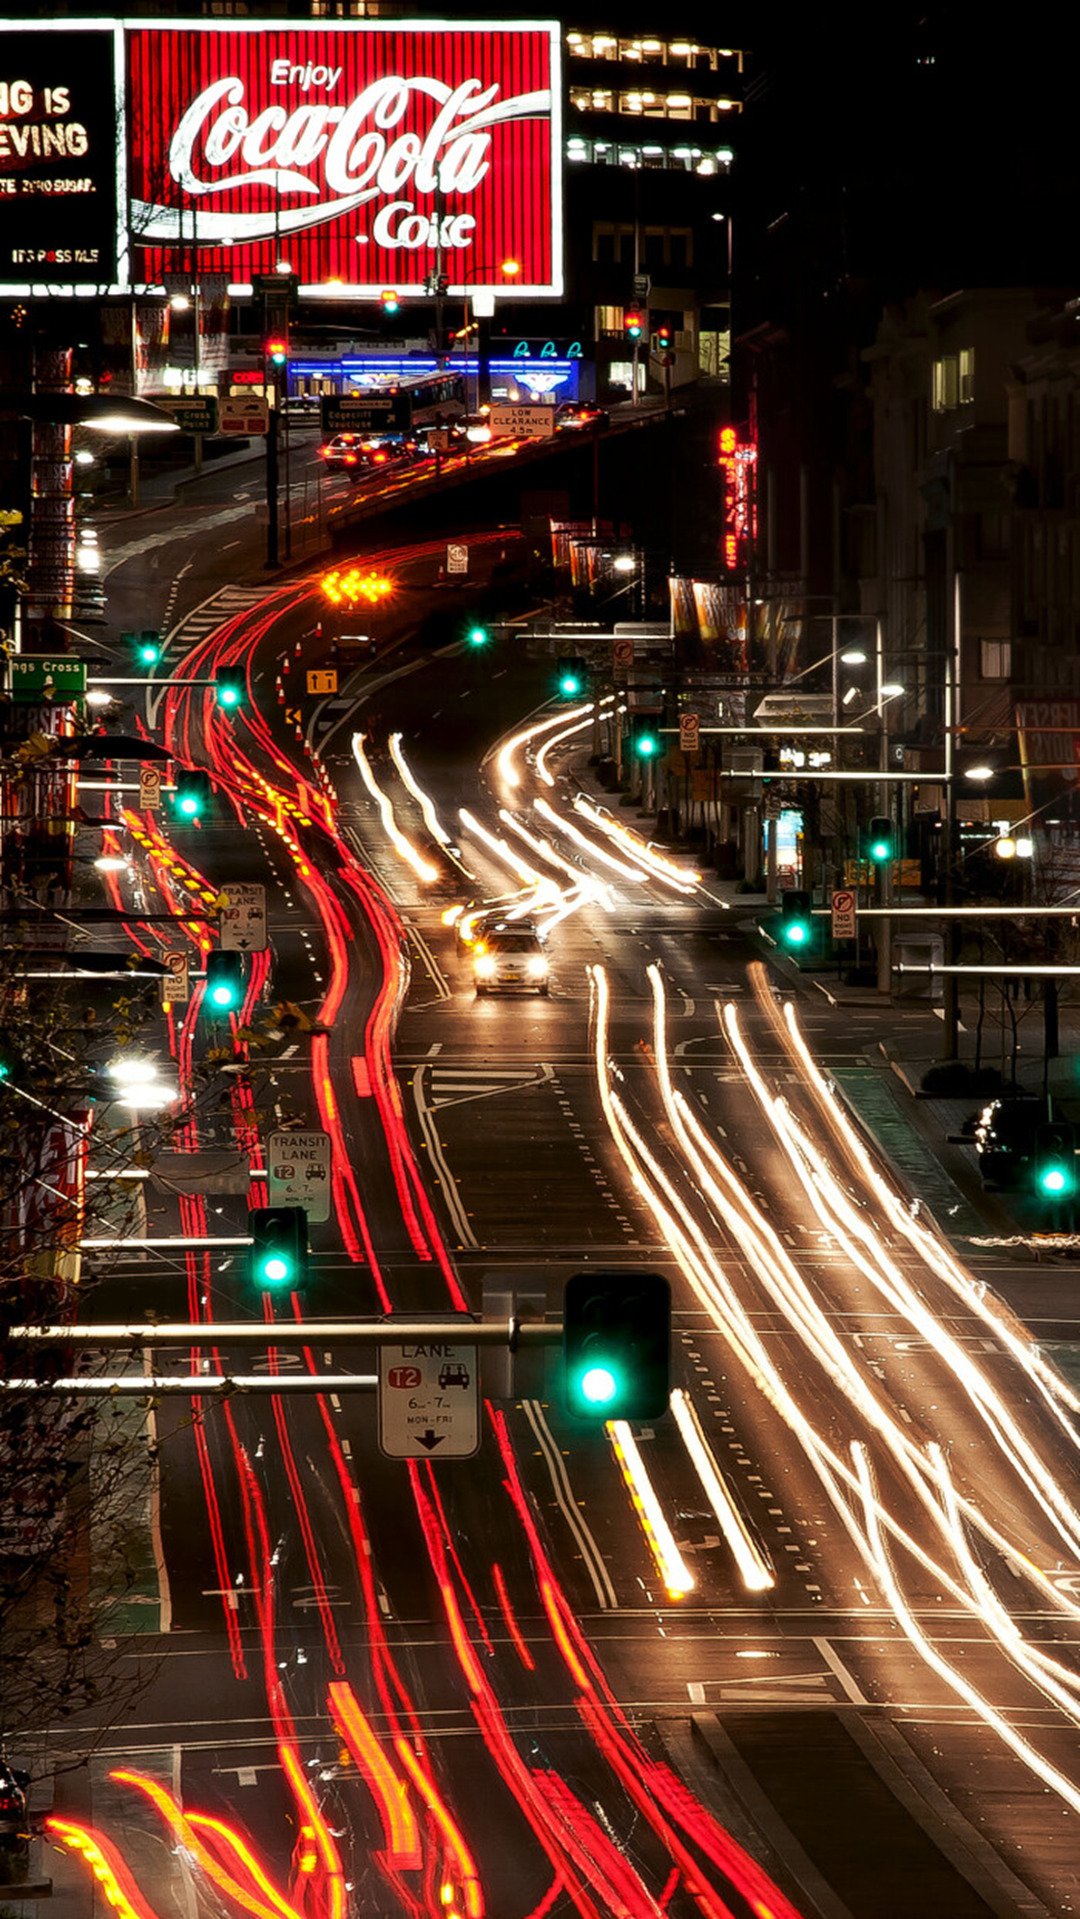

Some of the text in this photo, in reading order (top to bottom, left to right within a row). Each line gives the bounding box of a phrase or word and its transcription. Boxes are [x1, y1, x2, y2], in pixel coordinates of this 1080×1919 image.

[271, 59, 342, 91] Enjoy
[44, 87, 71, 114] IS
[169, 76, 498, 194] Coca-Cola
[373, 201, 477, 248] Coke
[493, 417, 550, 425] CLEARANCE
[42, 661, 80, 672] Cross
[837, 914, 849, 922] NO
[273, 1136, 328, 1147] TRANSIT
[282, 1150, 317, 1160] LANE
[276, 1166, 293, 1178] T2
[402, 1344, 455, 1358] LANE
[392, 1369, 418, 1386] T2
